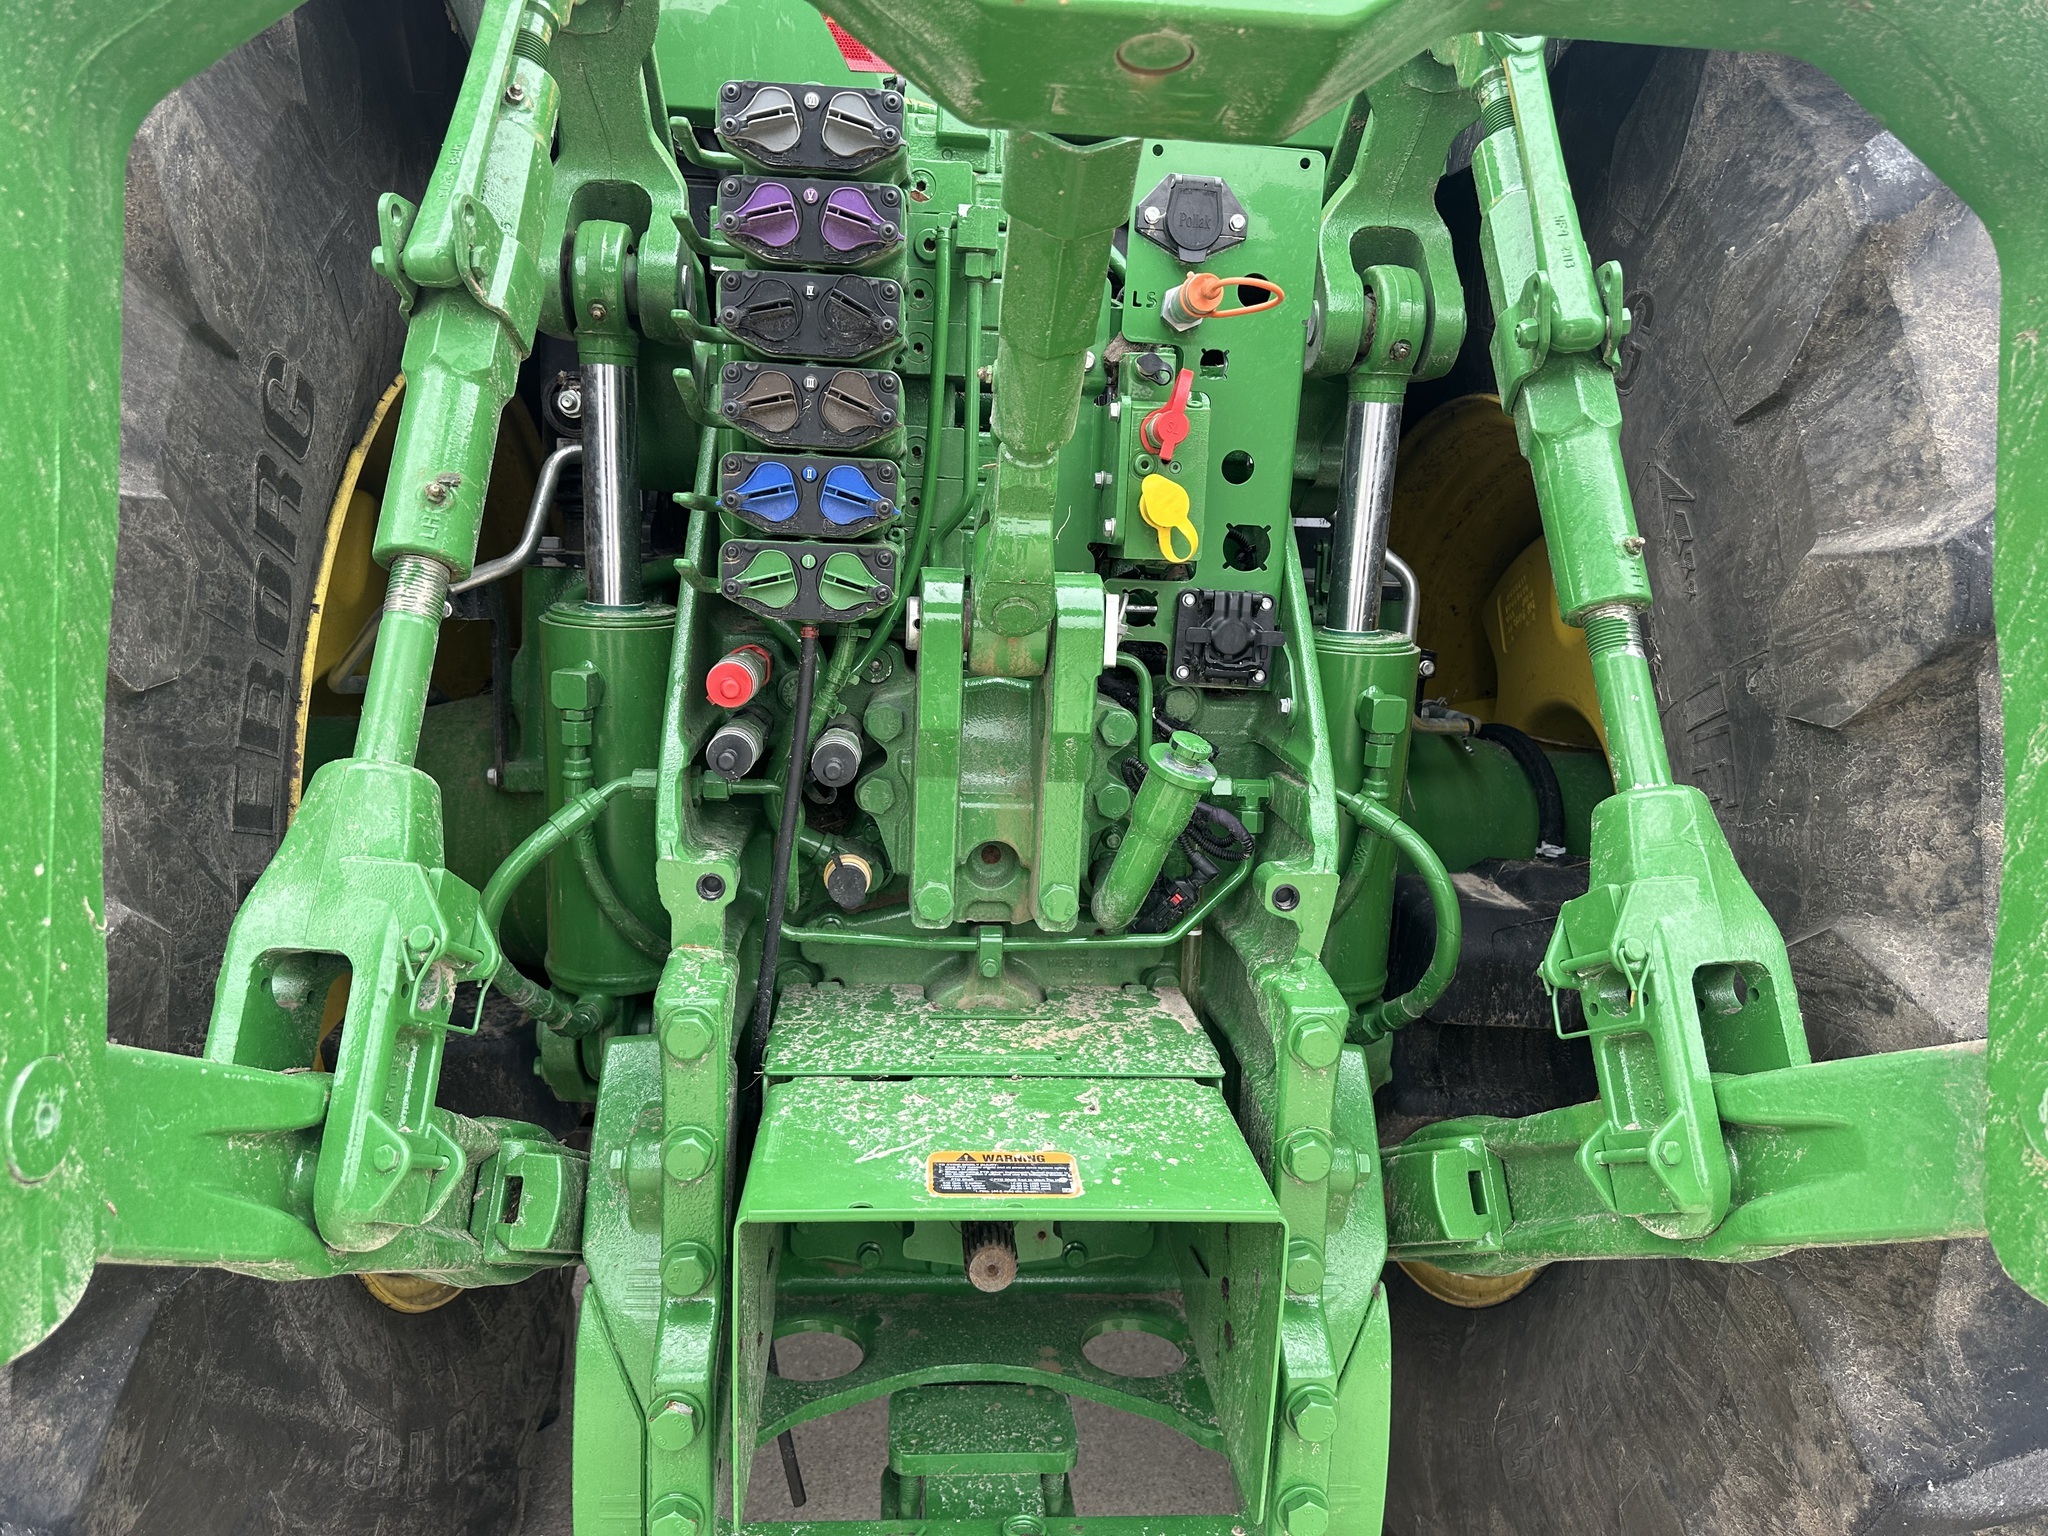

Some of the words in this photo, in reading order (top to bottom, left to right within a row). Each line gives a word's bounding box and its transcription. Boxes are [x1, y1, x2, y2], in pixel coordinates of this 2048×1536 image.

[1179, 212, 1212, 230] Pollak
[231, 349, 317, 910] EBORG
[982, 1154, 1046, 1163] WARNING
